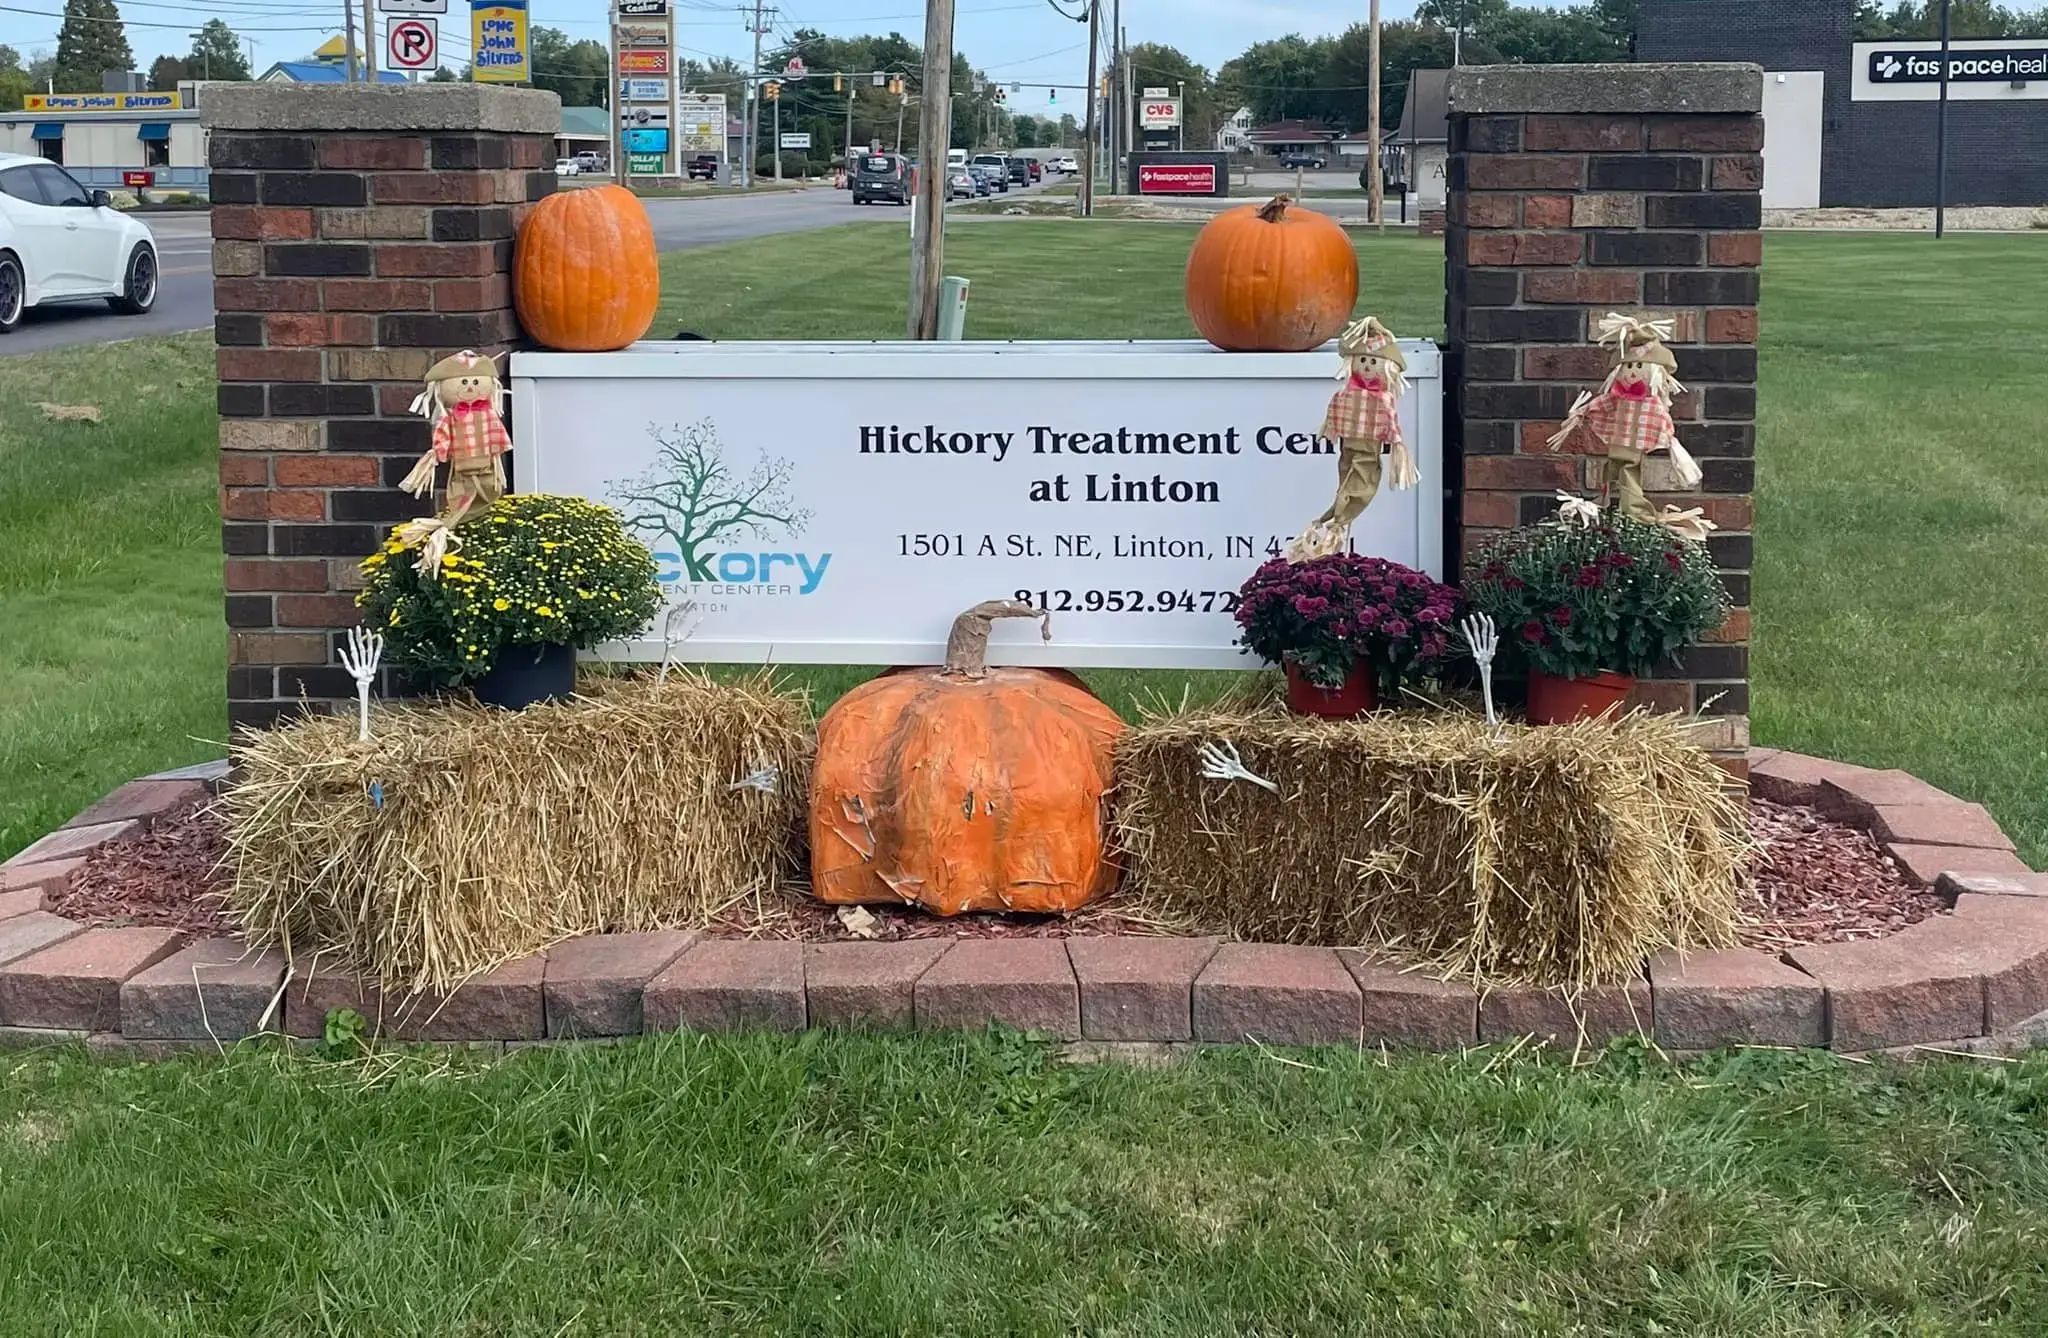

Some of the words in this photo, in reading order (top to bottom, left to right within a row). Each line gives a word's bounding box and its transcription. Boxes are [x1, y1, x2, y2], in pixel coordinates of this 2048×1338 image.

[626, 4, 658, 12] Center
[1146, 105, 1174, 115] CVS
[859, 425, 1014, 461] Hickory
[1026, 426, 1241, 454] Treatment
[1029, 475, 1070, 502] at
[1085, 473, 1220, 502] Linton
[897, 534, 966, 556] 1501
[977, 534, 997, 556] A
[1006, 534, 1042, 557] St.
[1055, 535, 1101, 559] NE,
[1113, 535, 1213, 560] Linton,
[1226, 536, 1254, 557] IN
[711, 584, 791, 595] CENTER
[1014, 589, 1239, 612] 812.952.9472
